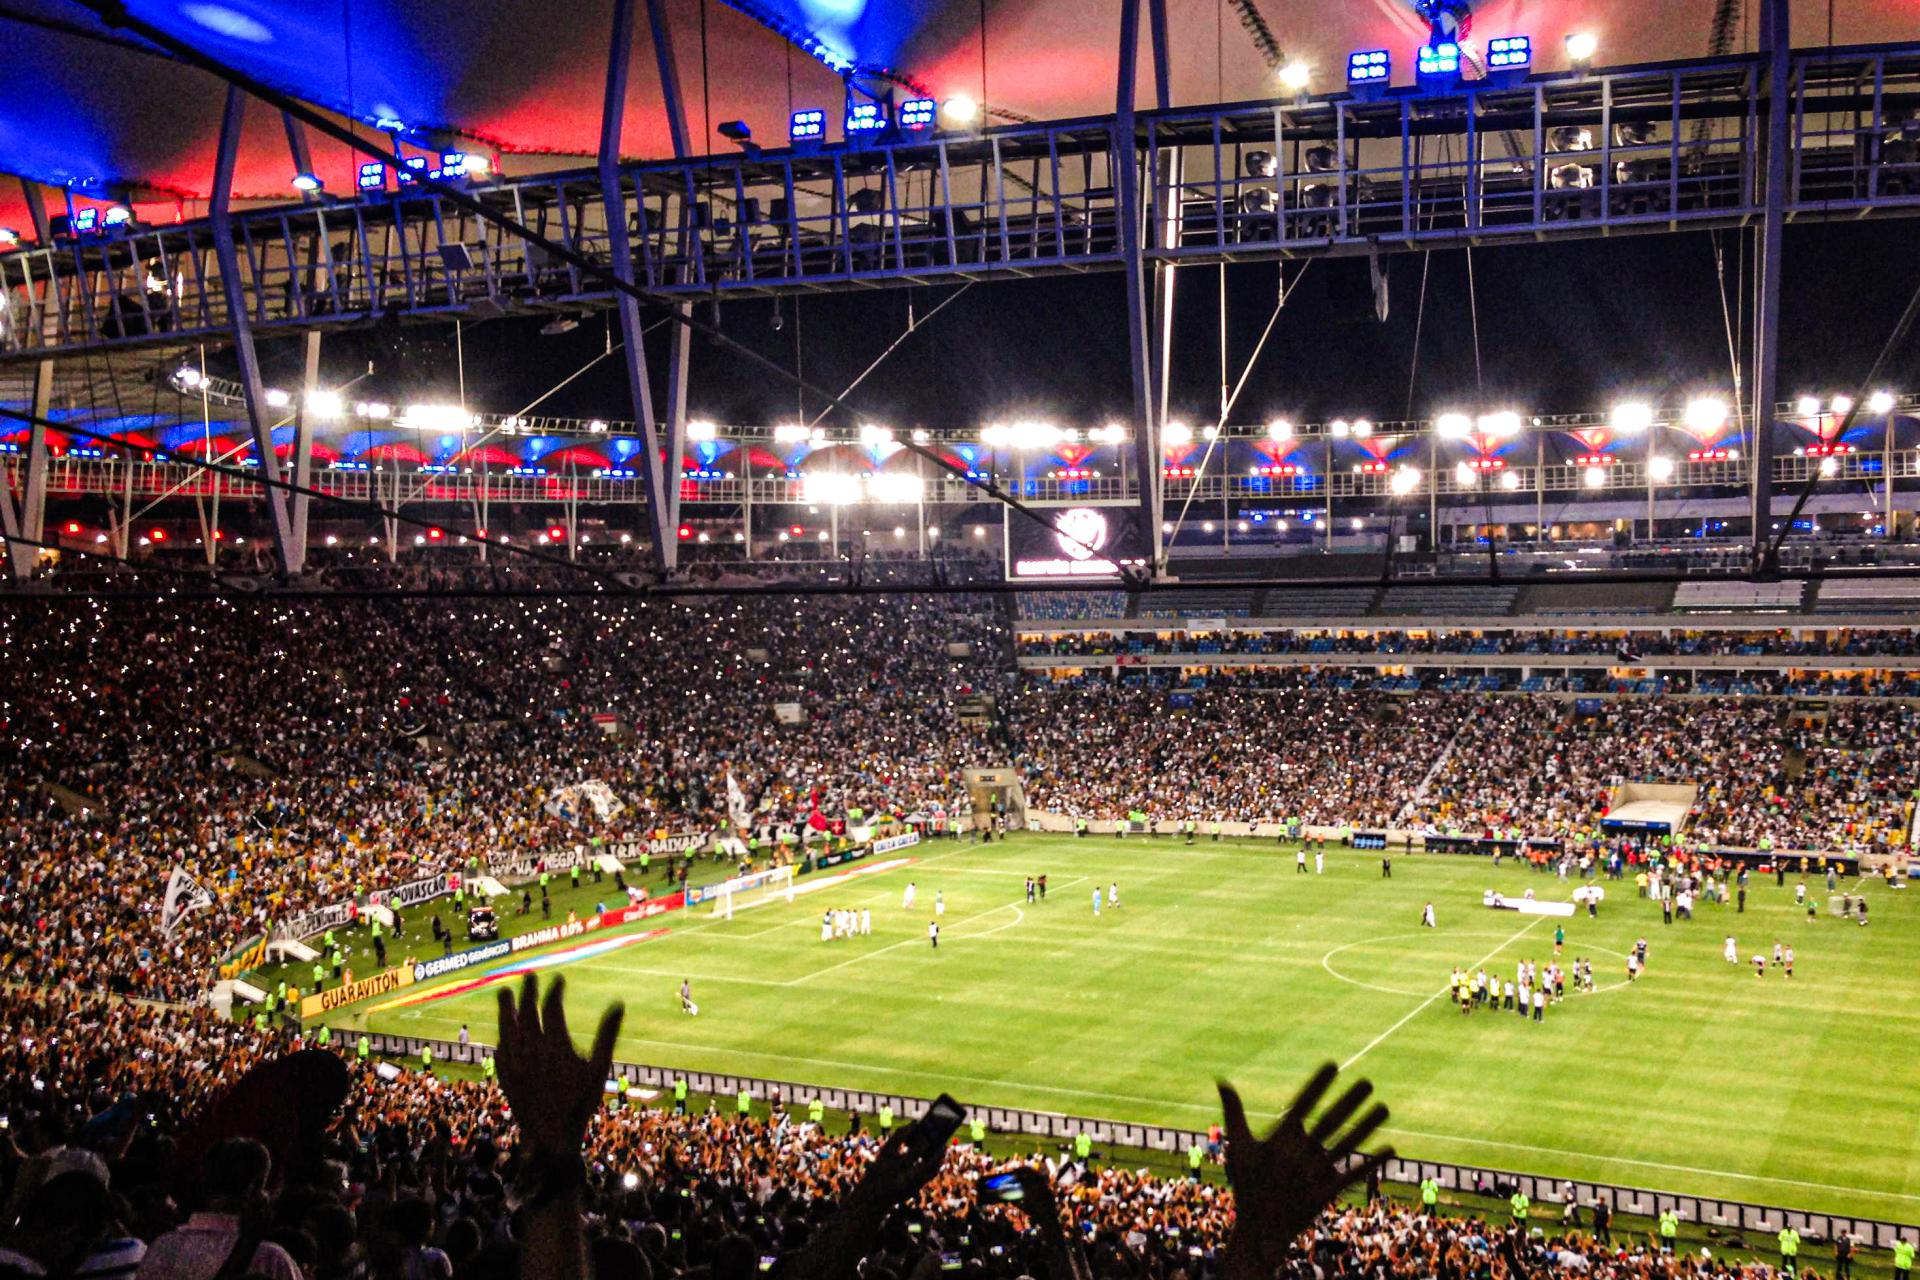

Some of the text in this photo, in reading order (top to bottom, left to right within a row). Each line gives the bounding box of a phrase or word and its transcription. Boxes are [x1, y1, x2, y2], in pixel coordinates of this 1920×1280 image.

[544, 847, 585, 871] NEGRA
[512, 928, 560, 951] BRAHMA
[560, 920, 584, 938] 0.0%
[425, 953, 468, 979] GERMED
[320, 971, 400, 1010] GUARAVITON
